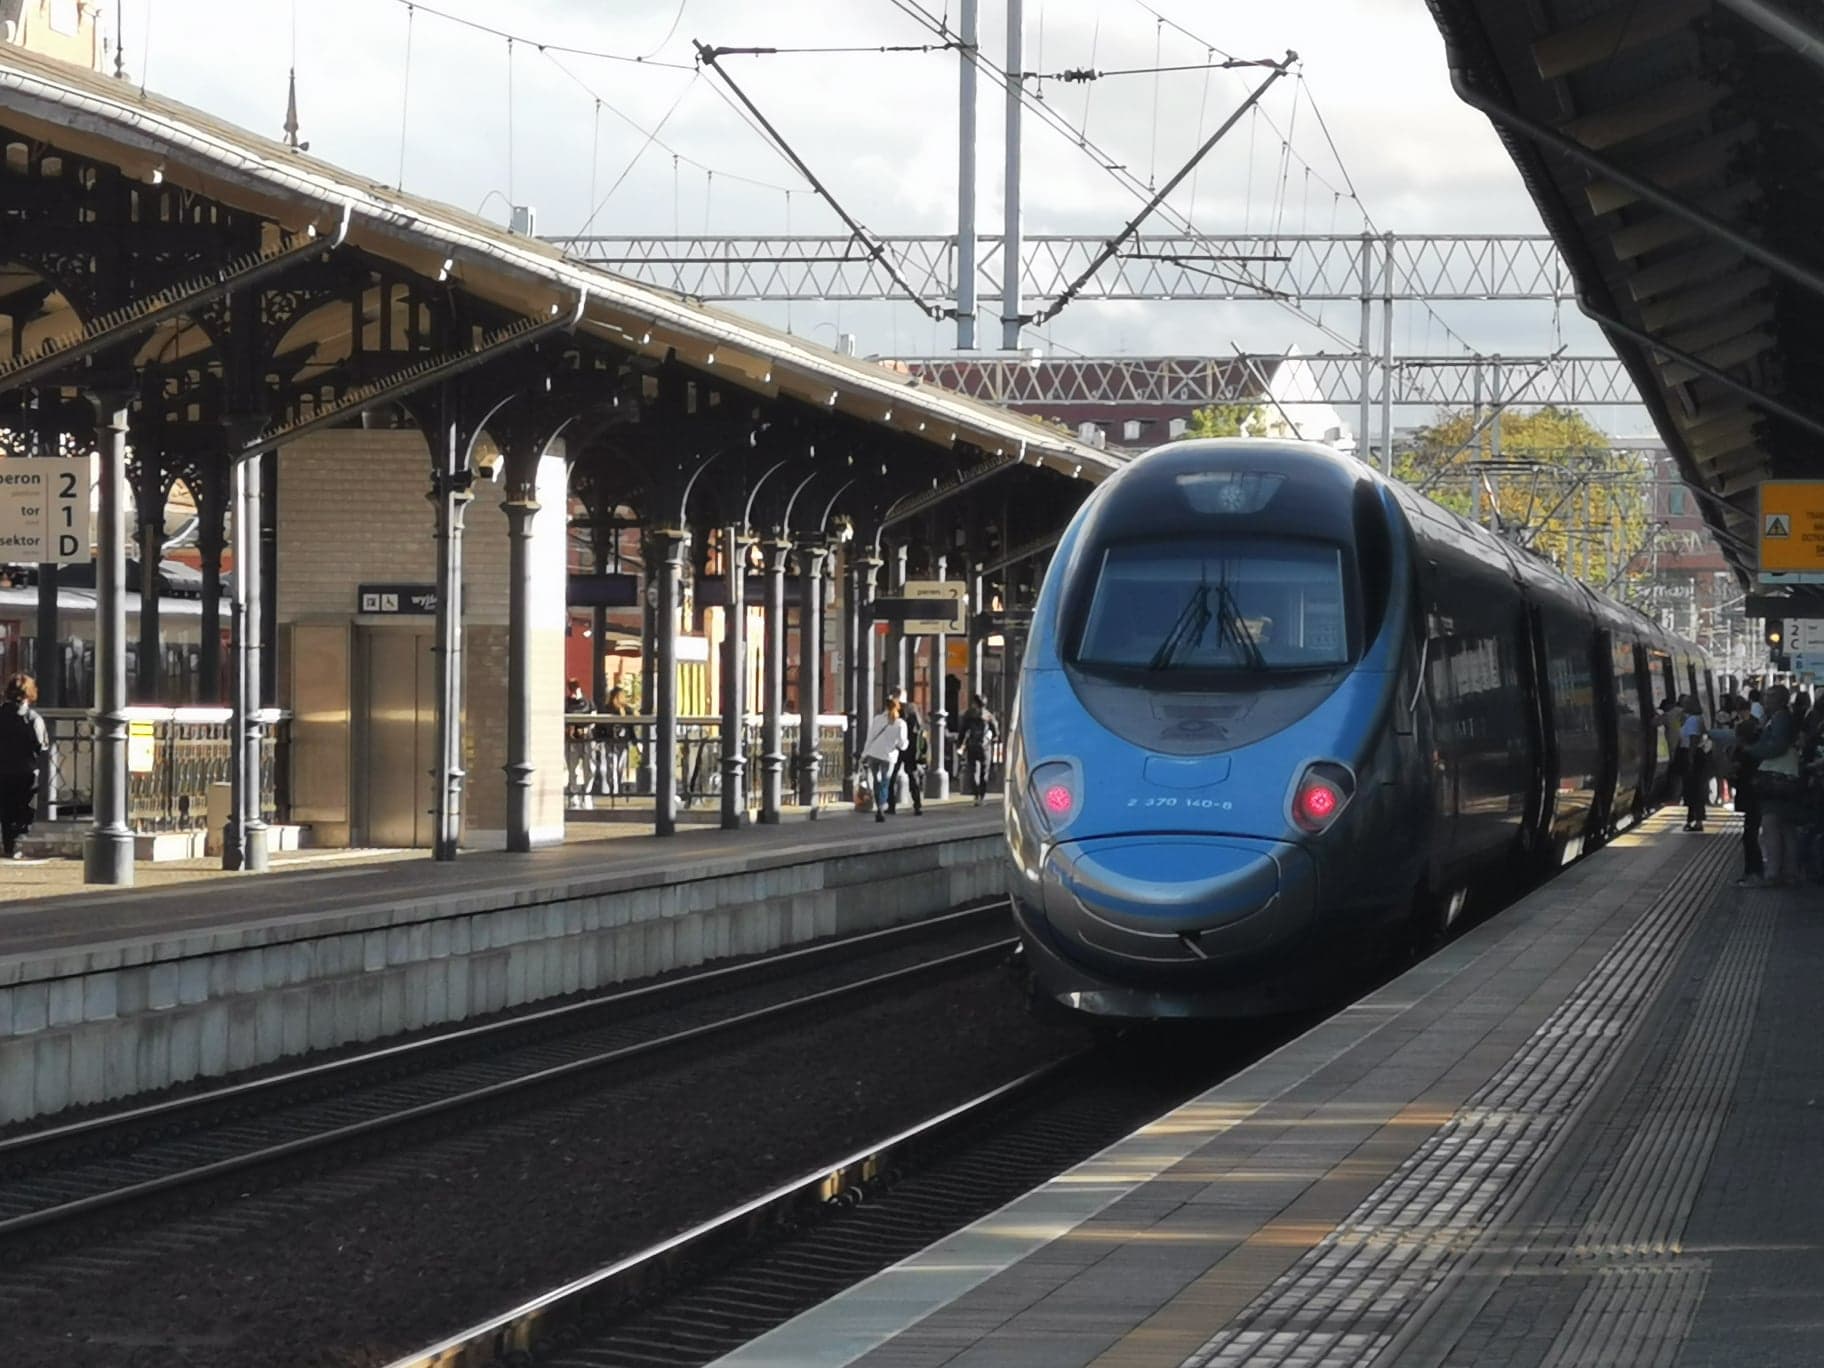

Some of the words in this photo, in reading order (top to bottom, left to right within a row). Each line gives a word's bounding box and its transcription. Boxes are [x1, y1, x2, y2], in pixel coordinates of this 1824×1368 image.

[59, 473, 77, 498] 2
[21, 506, 39, 516] tor
[62, 506, 72, 527] 1
[60, 535, 79, 556] D
[1791, 625, 1799, 635] 2
[1791, 639, 1799, 649] C
